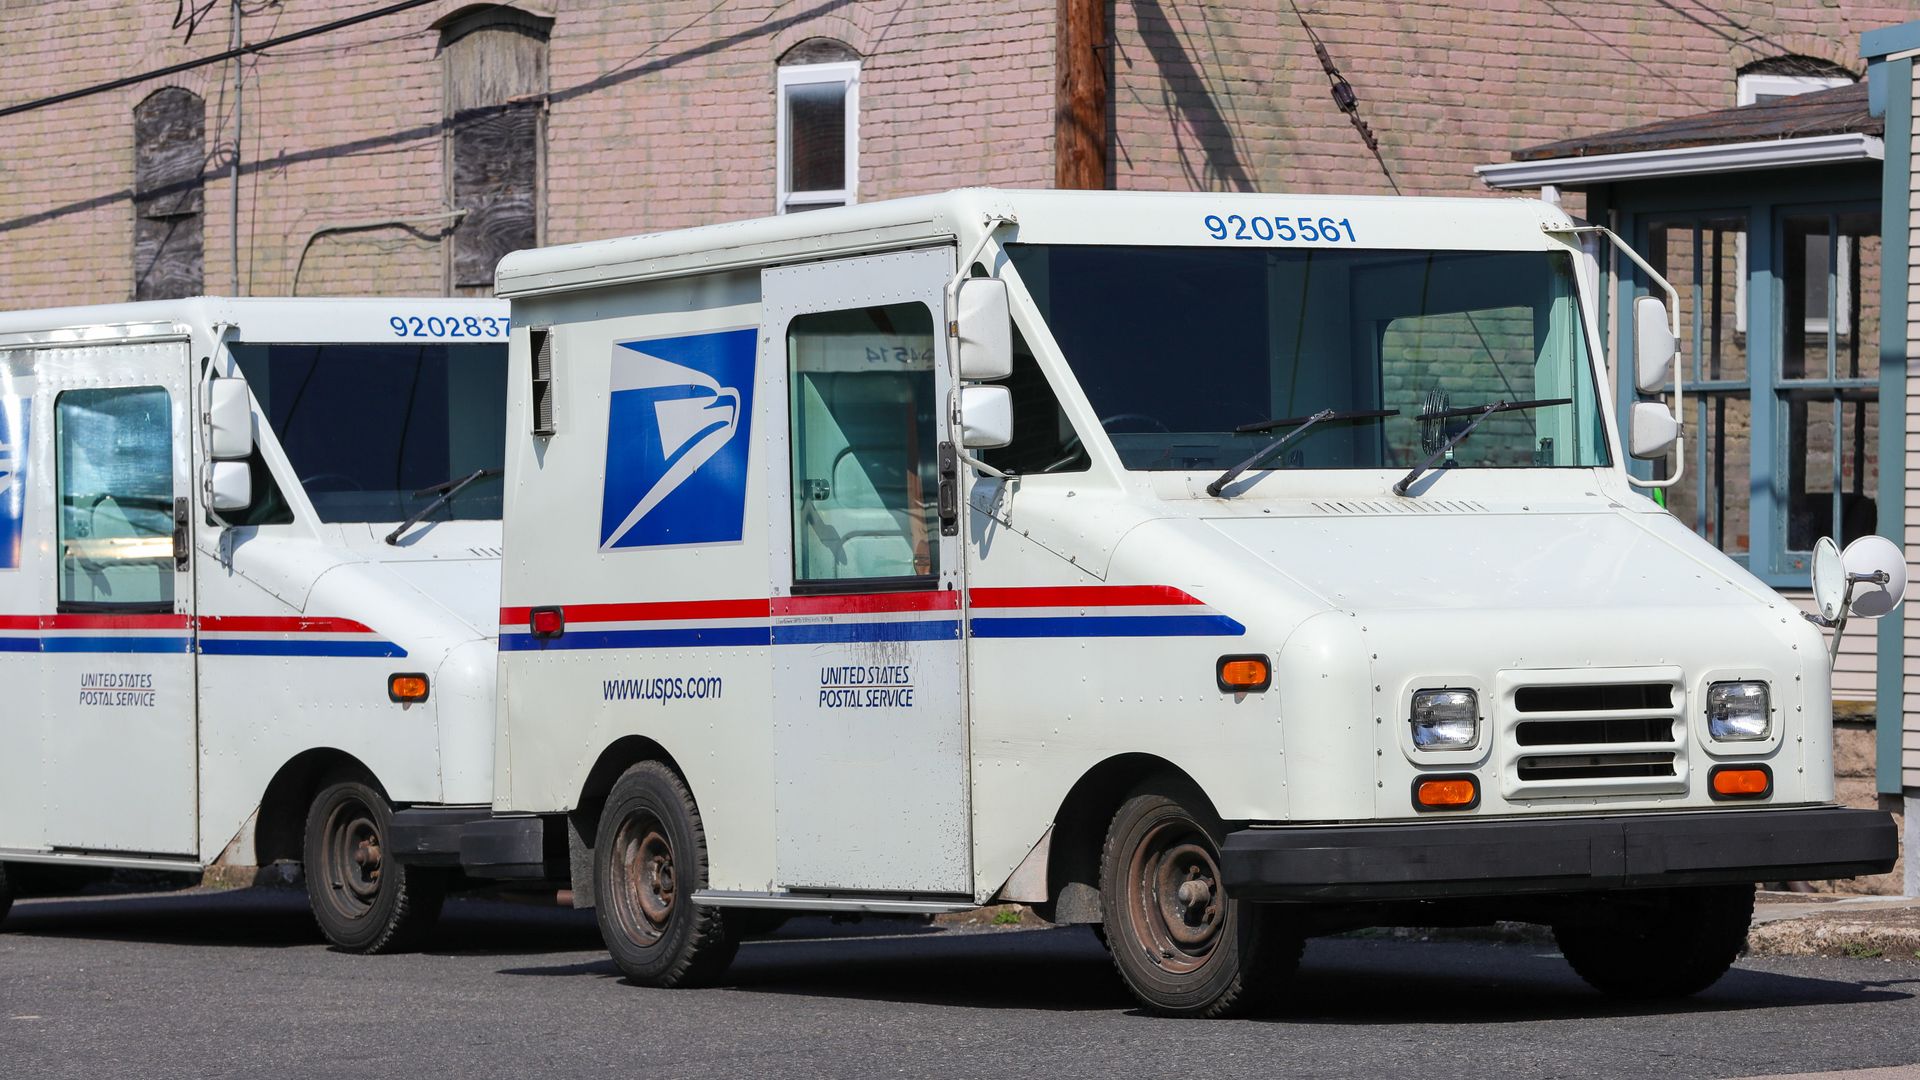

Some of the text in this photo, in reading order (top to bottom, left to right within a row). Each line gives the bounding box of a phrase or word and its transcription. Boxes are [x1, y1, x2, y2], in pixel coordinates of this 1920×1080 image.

[1204, 214, 1356, 243] 9205561
[389, 316, 511, 337] 9202837
[81, 673, 152, 688] UNITED STATES
[821, 665, 909, 685] UNITED STATES
[79, 691, 156, 707] POSTAL SERVICE
[603, 677, 722, 706] www.usps.com
[819, 689, 914, 708] POSTAL SERVICE
